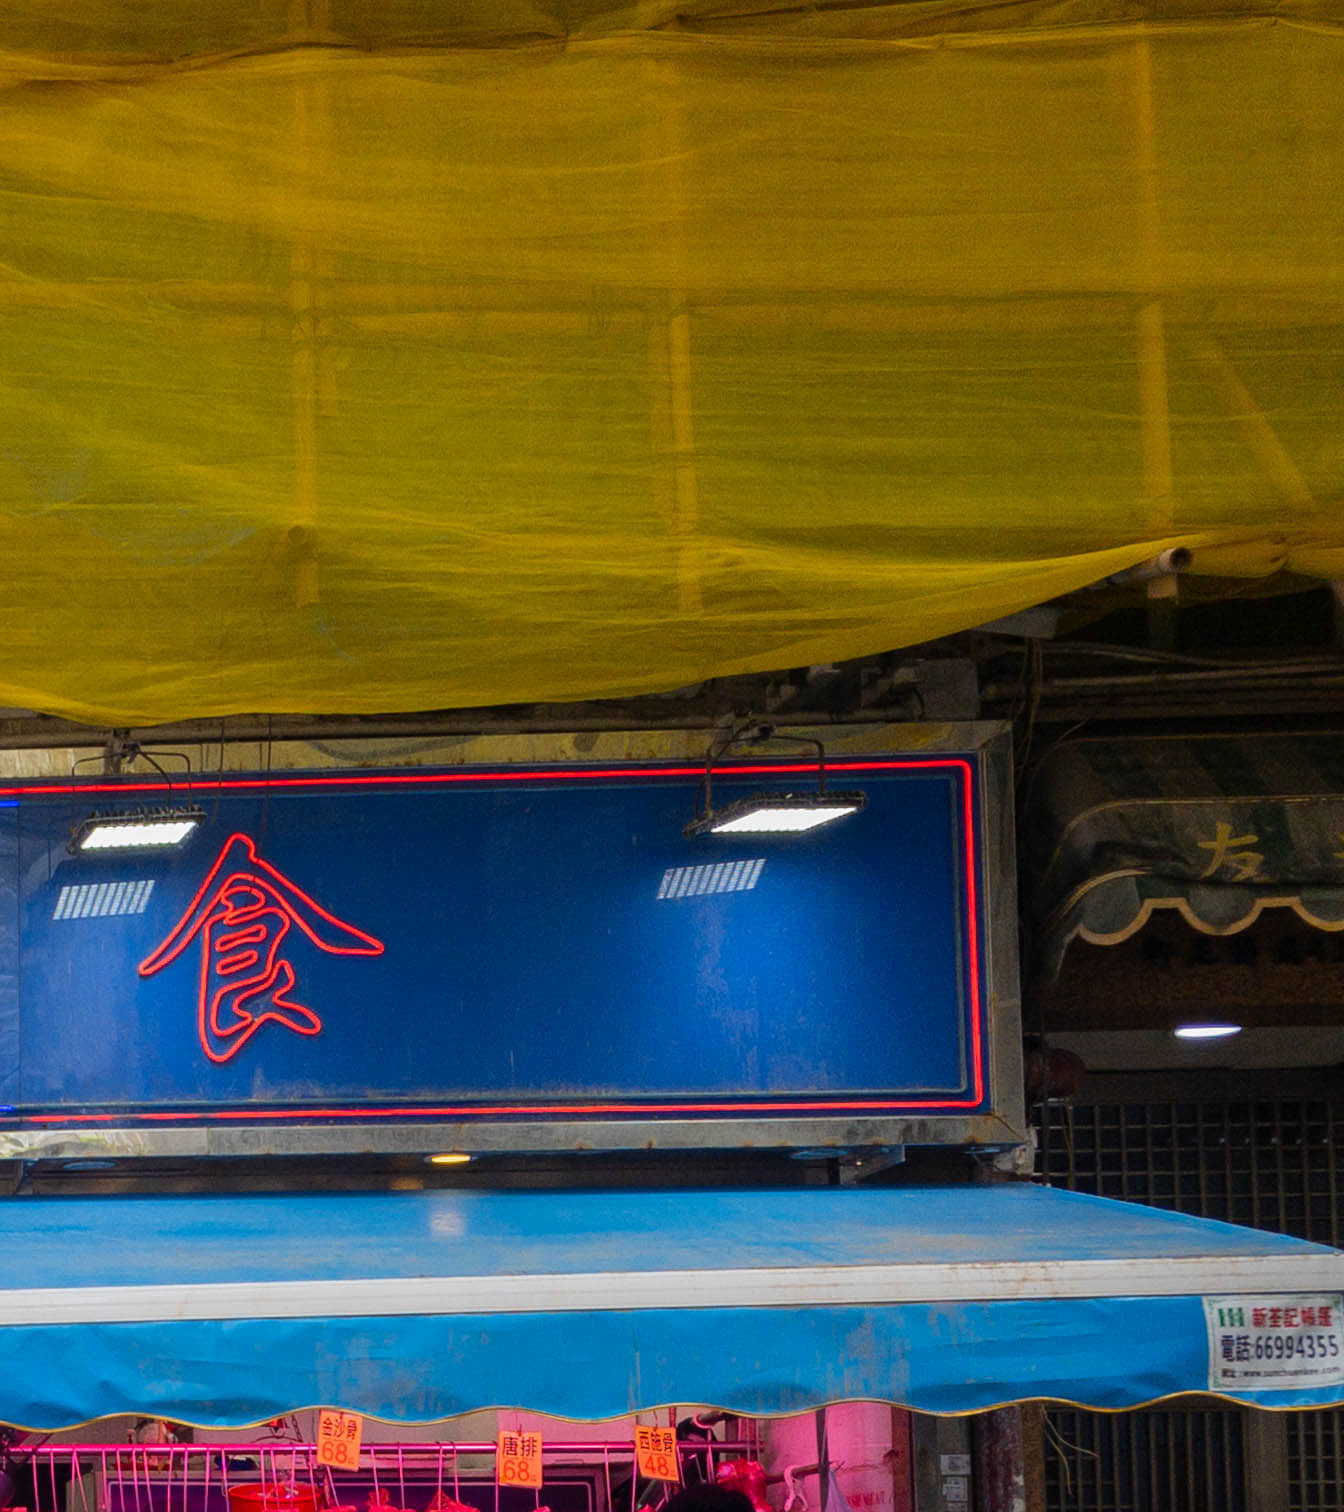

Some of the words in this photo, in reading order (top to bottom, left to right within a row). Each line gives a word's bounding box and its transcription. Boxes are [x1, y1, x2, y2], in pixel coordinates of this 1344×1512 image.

[321, 1440, 348, 1464] 68
[502, 1436, 538, 1457] 唐排
[502, 1459, 530, 1482] 68
[644, 1455, 670, 1477] 48
